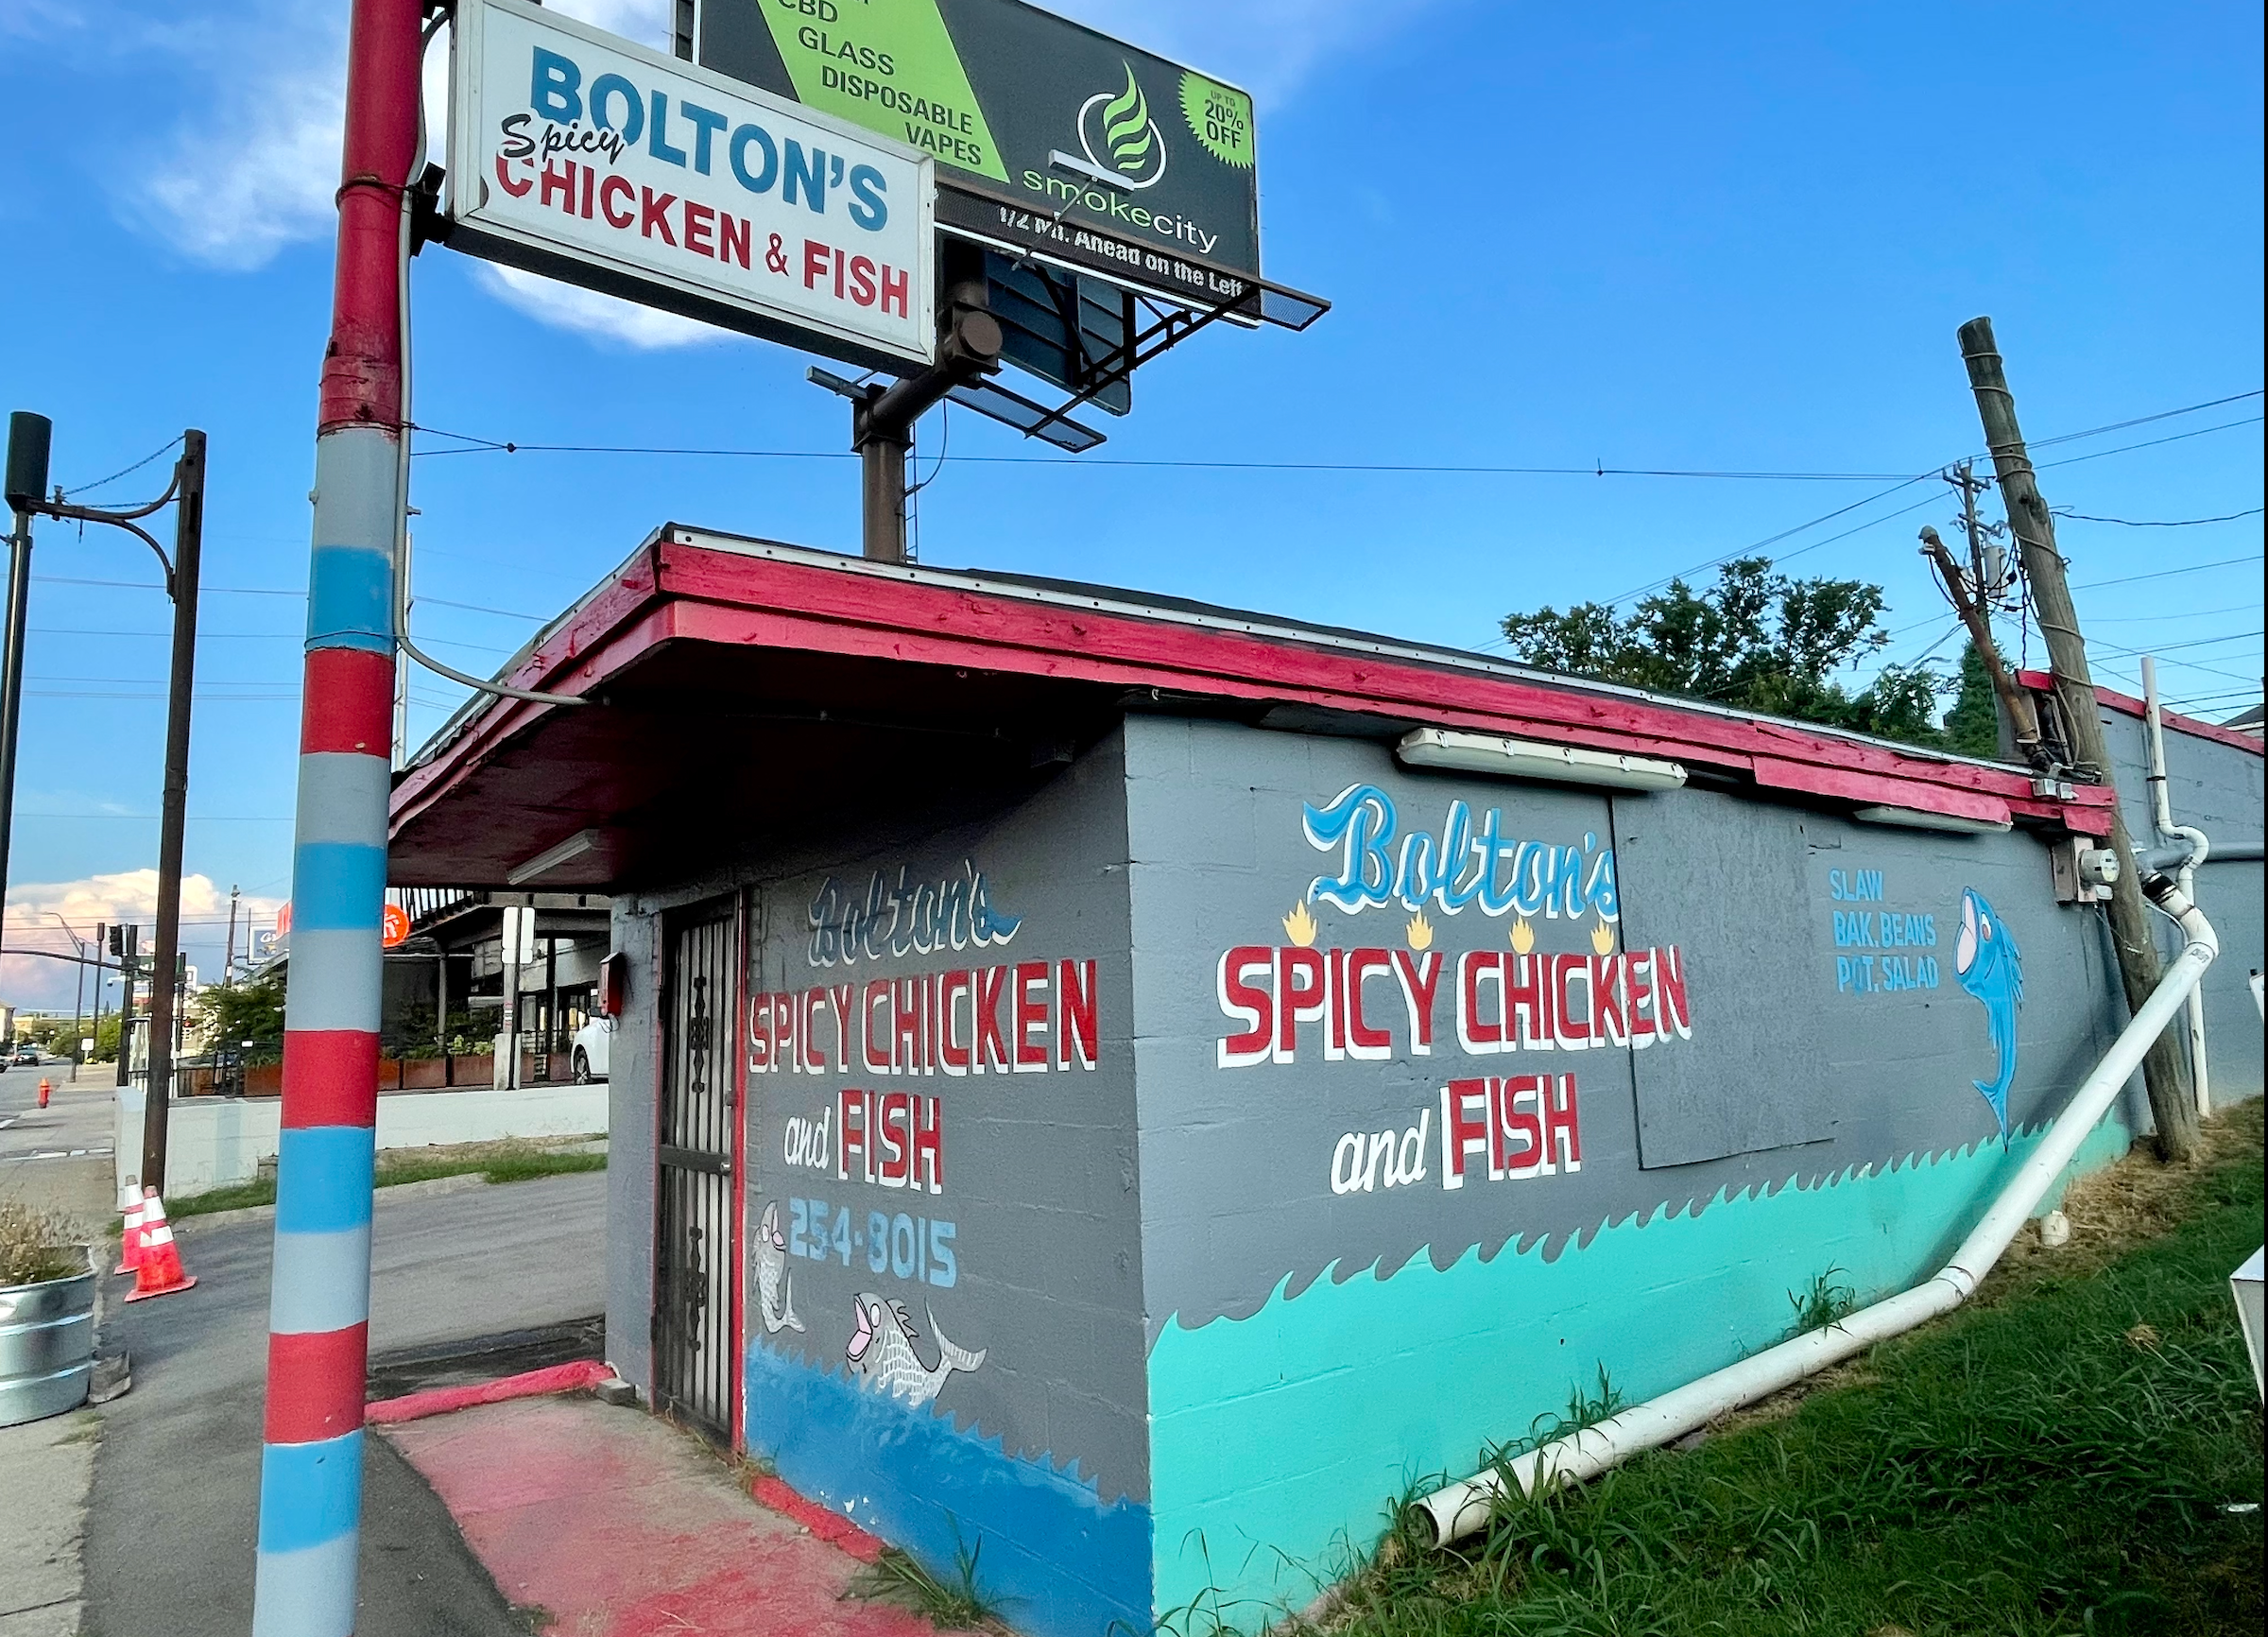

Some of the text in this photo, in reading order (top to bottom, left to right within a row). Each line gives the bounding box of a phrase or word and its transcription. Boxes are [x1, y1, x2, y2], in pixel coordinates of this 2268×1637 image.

[798, 26, 894, 76] GLASS
[821, 64, 973, 135] DISPOSABLE
[1204, 98, 1244, 130] 20%
[1211, 90, 1236, 107] UP TO
[501, 113, 626, 165] Spicy
[530, 45, 888, 232] BOLTON'S
[904, 122, 981, 165] VAPES
[1206, 120, 1241, 148] OFF
[495, 142, 909, 319] CHICKEN & FISH
[1022, 169, 1218, 254] smokecity
[1144, 252, 1170, 275] on
[1302, 783, 1621, 922] Bolton's
[1830, 869, 1883, 902] SLAW
[1833, 910, 1936, 948] BAK. BEANS
[1837, 955, 1939, 993] POT. SALAD
[749, 958, 1098, 1077] SPICY CHICKEN
[1216, 944, 1693, 1069] SPICY CHICKEN
[783, 1089, 943, 1195] and FISH
[1330, 1072, 1582, 1195] and FISH
[788, 1197, 958, 1289] 254-8015
